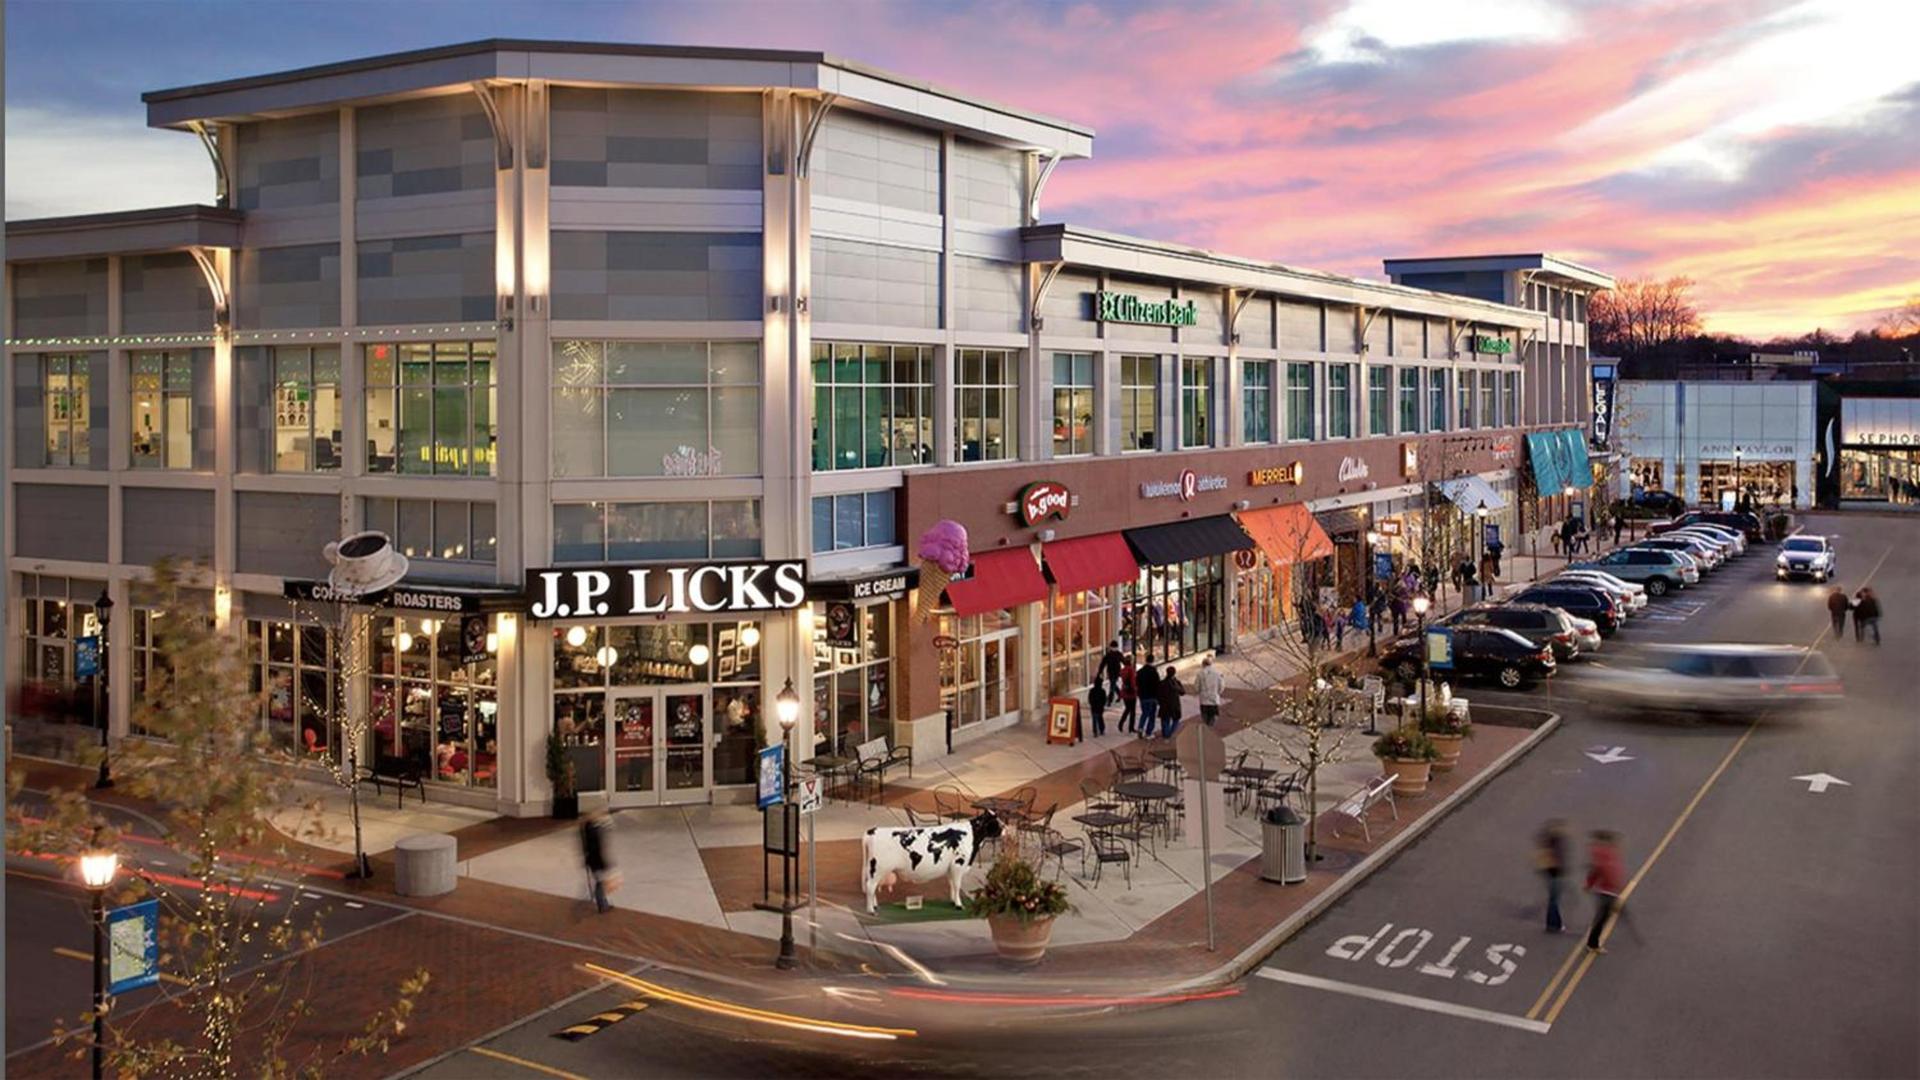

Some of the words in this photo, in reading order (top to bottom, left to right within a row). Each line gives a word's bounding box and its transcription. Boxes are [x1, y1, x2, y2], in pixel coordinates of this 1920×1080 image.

[1117, 294, 1168, 323] Citizens
[1168, 298, 1197, 326] Bank
[1594, 382, 1607, 441] LEGAL
[1252, 467, 1293, 486] MERRELL
[394, 592, 462, 611] ROASTERS
[531, 571, 611, 617] J.P.
[628, 563, 805, 614] LICKS
[854, 583, 872, 597] ICE
[873, 576, 906, 594] CREAM
[1325, 922, 1527, 986] STOP
